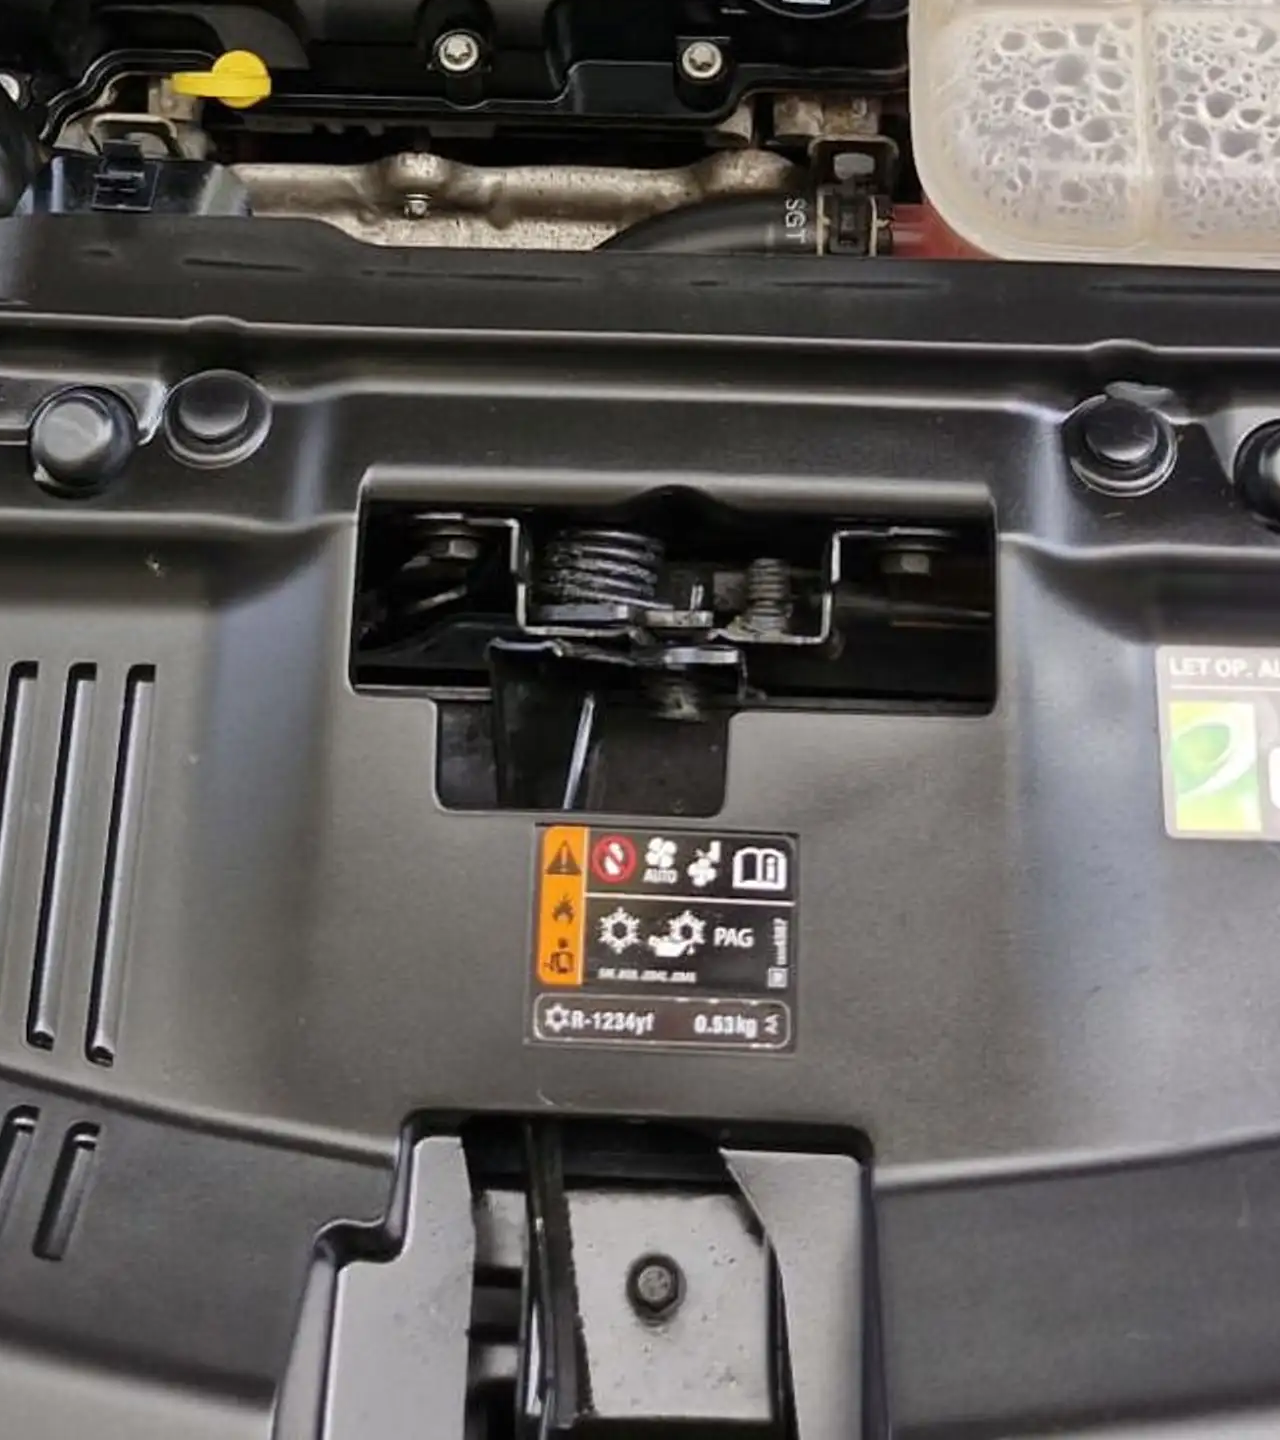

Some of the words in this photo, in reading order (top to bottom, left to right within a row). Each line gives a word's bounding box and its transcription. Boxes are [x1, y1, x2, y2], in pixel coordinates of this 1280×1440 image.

[1170, 657, 1212, 677] LET
[644, 868, 678, 884] AUTO
[714, 927, 754, 948] PAG
[571, 1012, 655, 1035] R-1234yf
